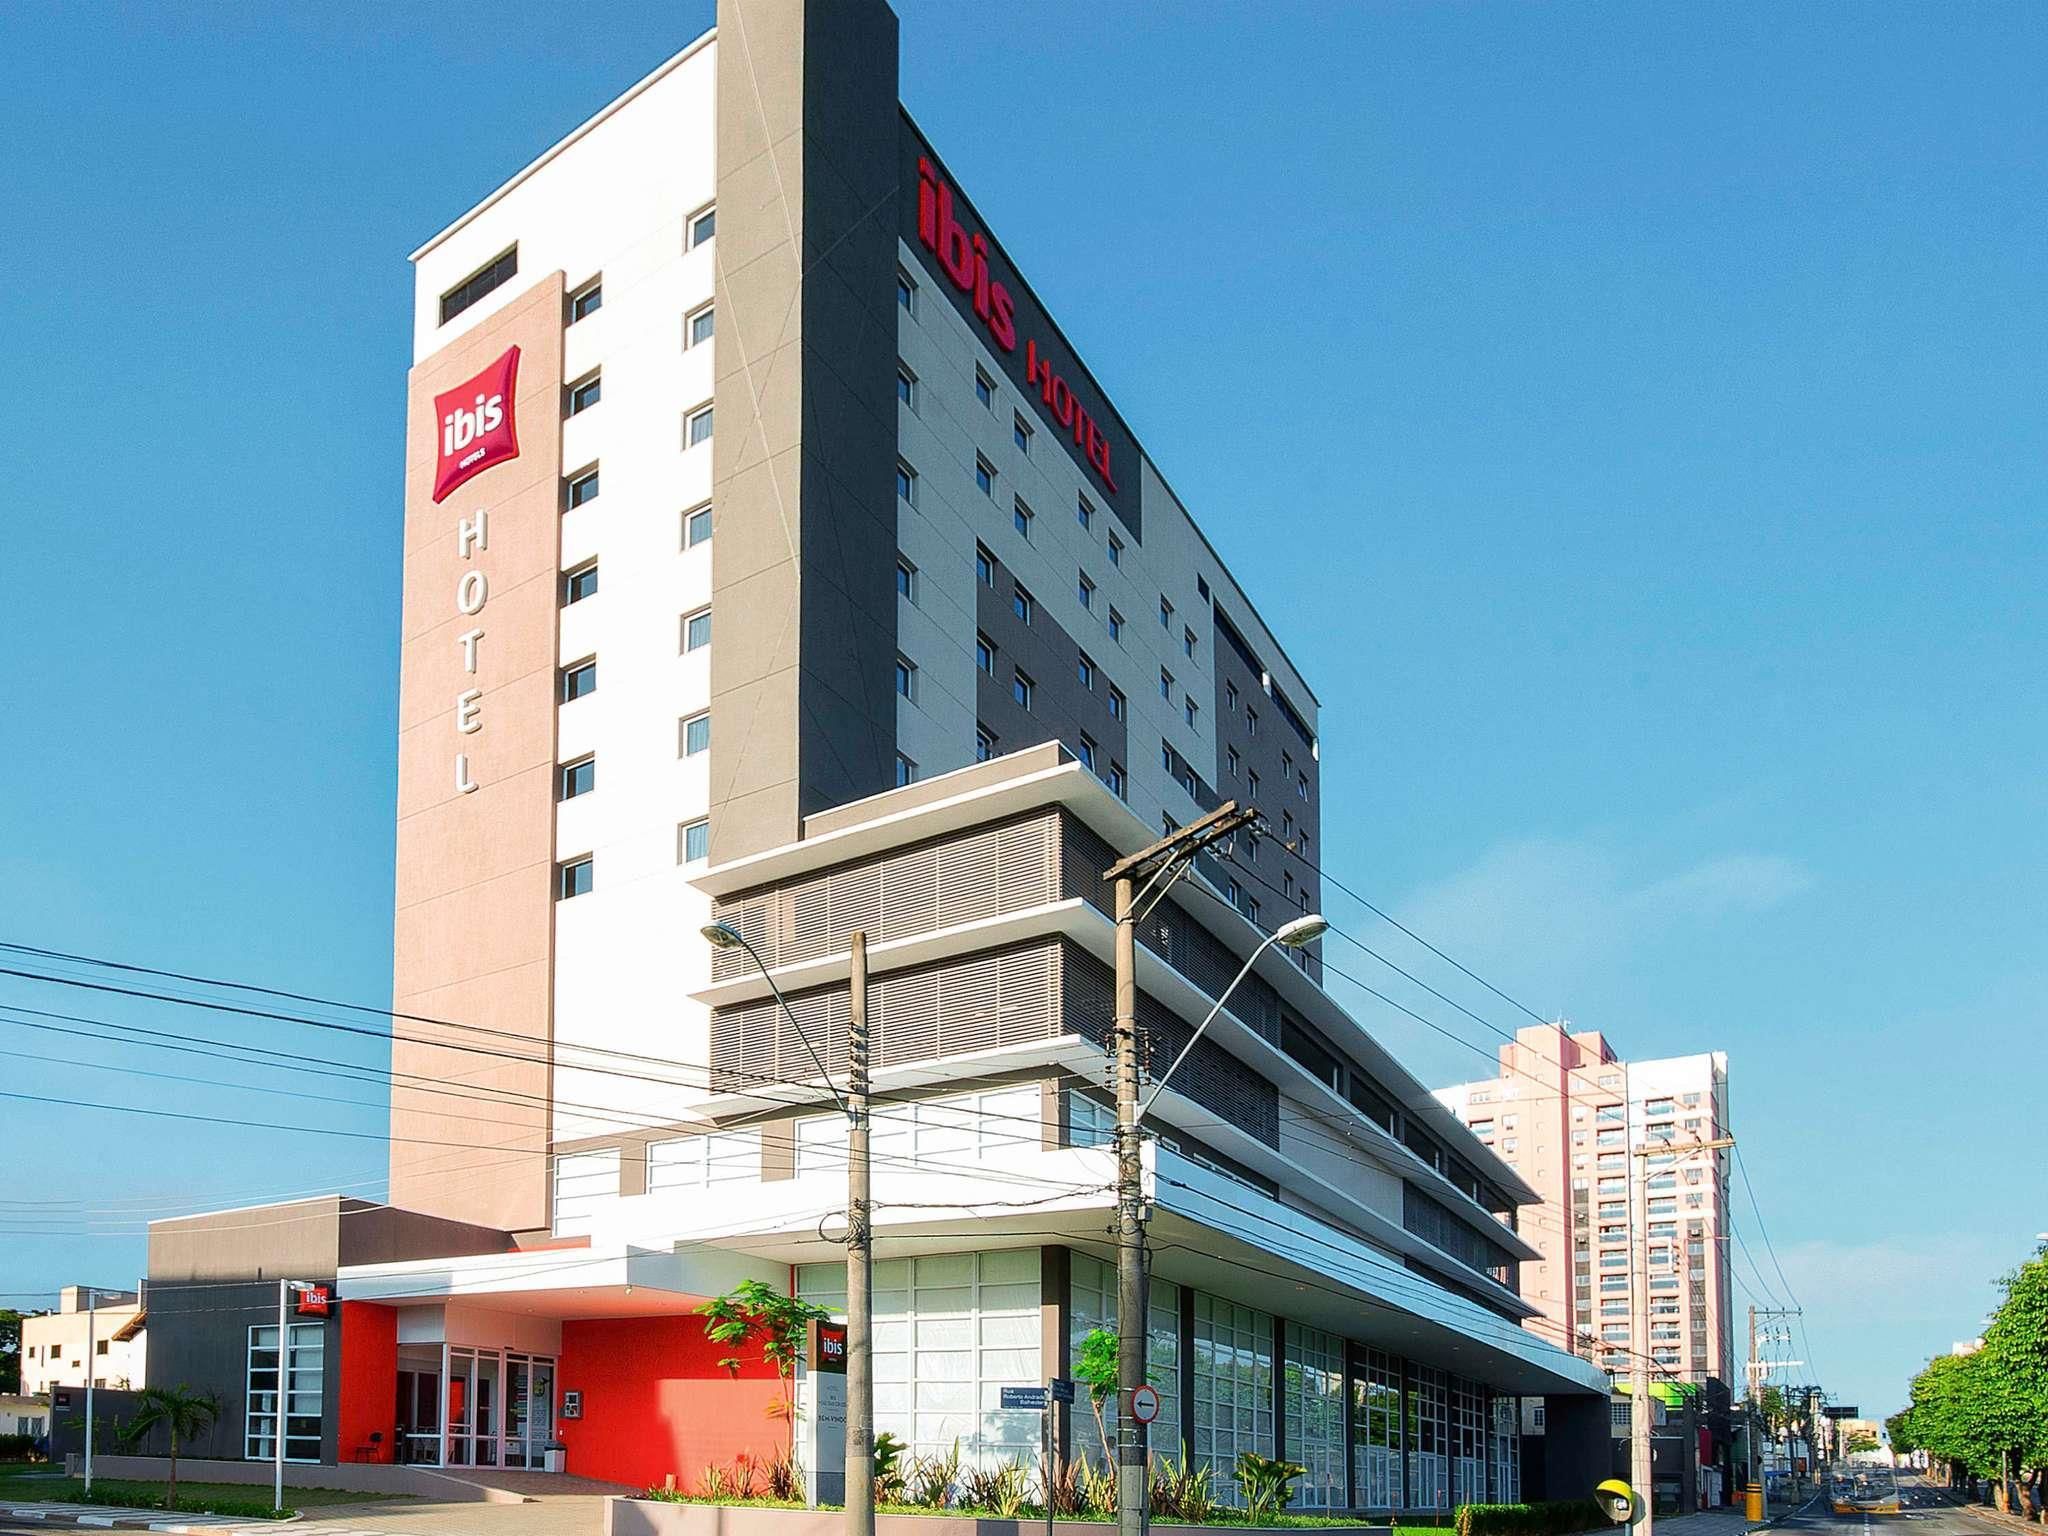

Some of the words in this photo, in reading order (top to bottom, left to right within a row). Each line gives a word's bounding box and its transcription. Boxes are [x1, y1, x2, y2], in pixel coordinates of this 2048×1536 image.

[918, 156, 1016, 352] ibis
[1027, 339, 1118, 495] HOTEL
[444, 393, 503, 457] ibis
[455, 508, 488, 794] HOTEL
[306, 1291, 327, 1304] ibis
[823, 1337, 843, 1355] ibis
